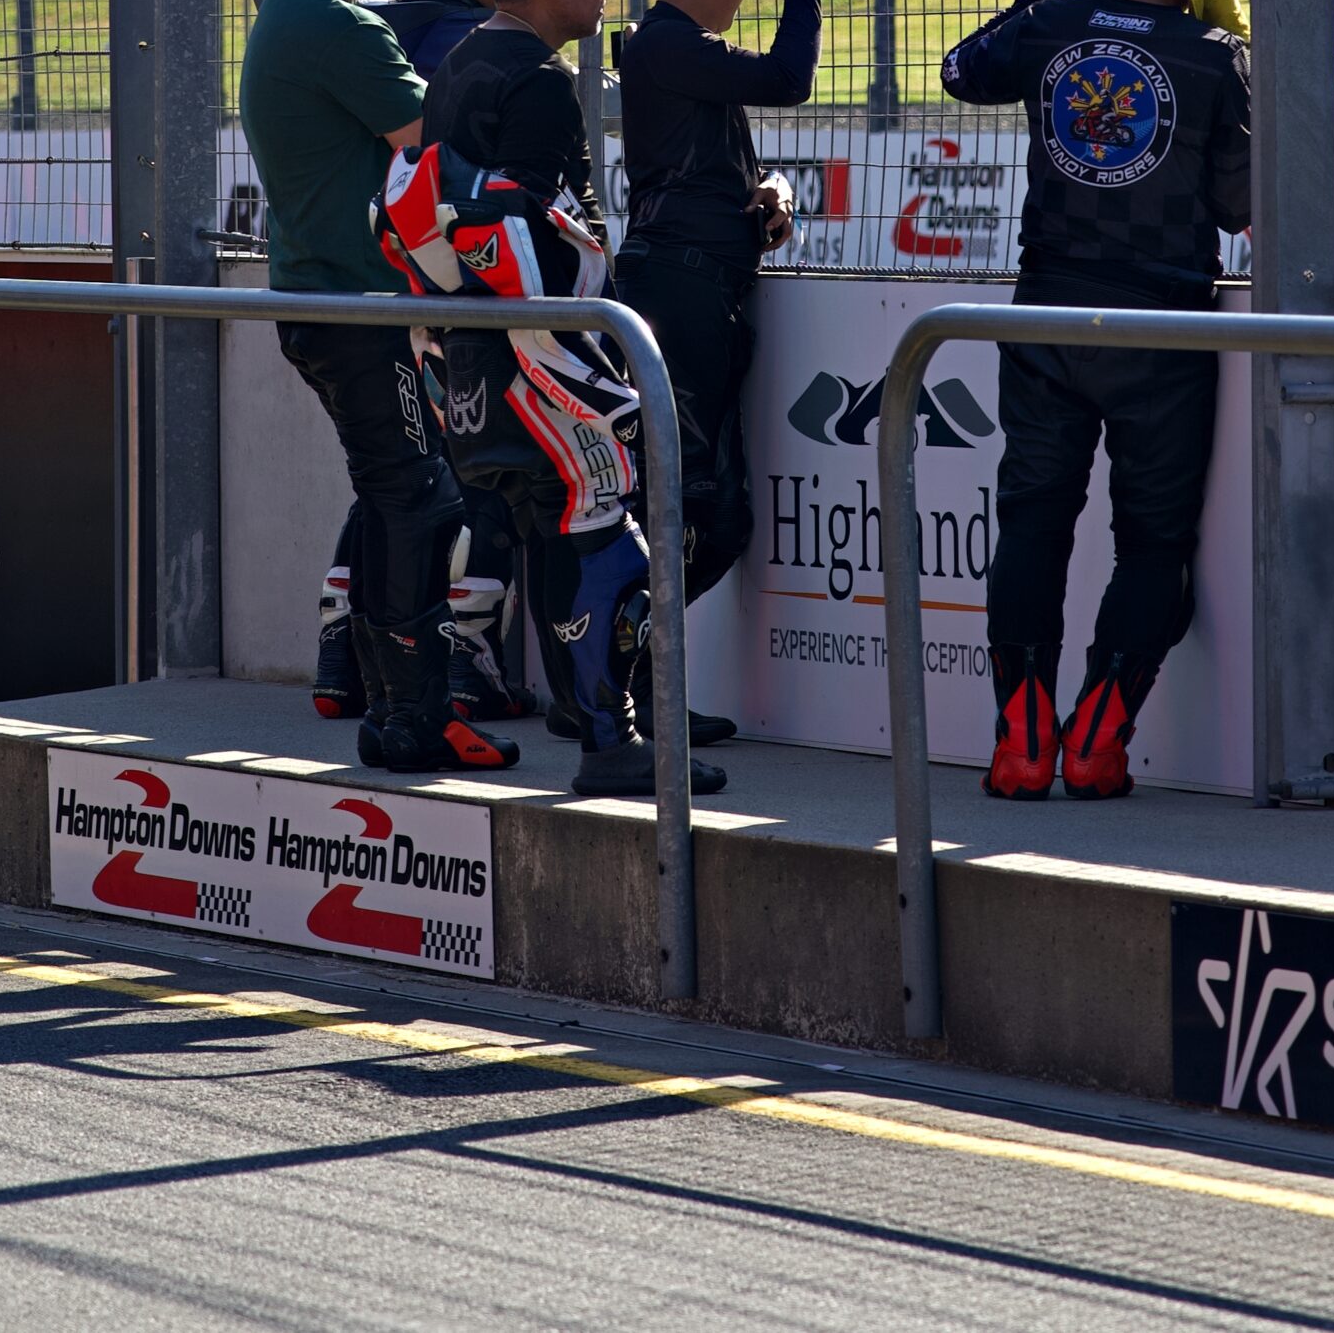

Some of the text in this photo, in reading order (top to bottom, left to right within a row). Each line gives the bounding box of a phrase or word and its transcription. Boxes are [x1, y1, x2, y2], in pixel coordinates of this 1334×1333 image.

[1046, 43, 1171, 103] NEW ZEALAND
[908, 152, 1005, 197] Hampton
[1047, 138, 1156, 184] PINOY RIDERS
[927, 194, 1000, 230] Downs
[395, 361, 428, 455] RST
[516, 345, 600, 423] BERIK
[770, 627, 866, 667] EXPERIENCE
[55, 786, 487, 898] Hampton Downs Hampton Downs
